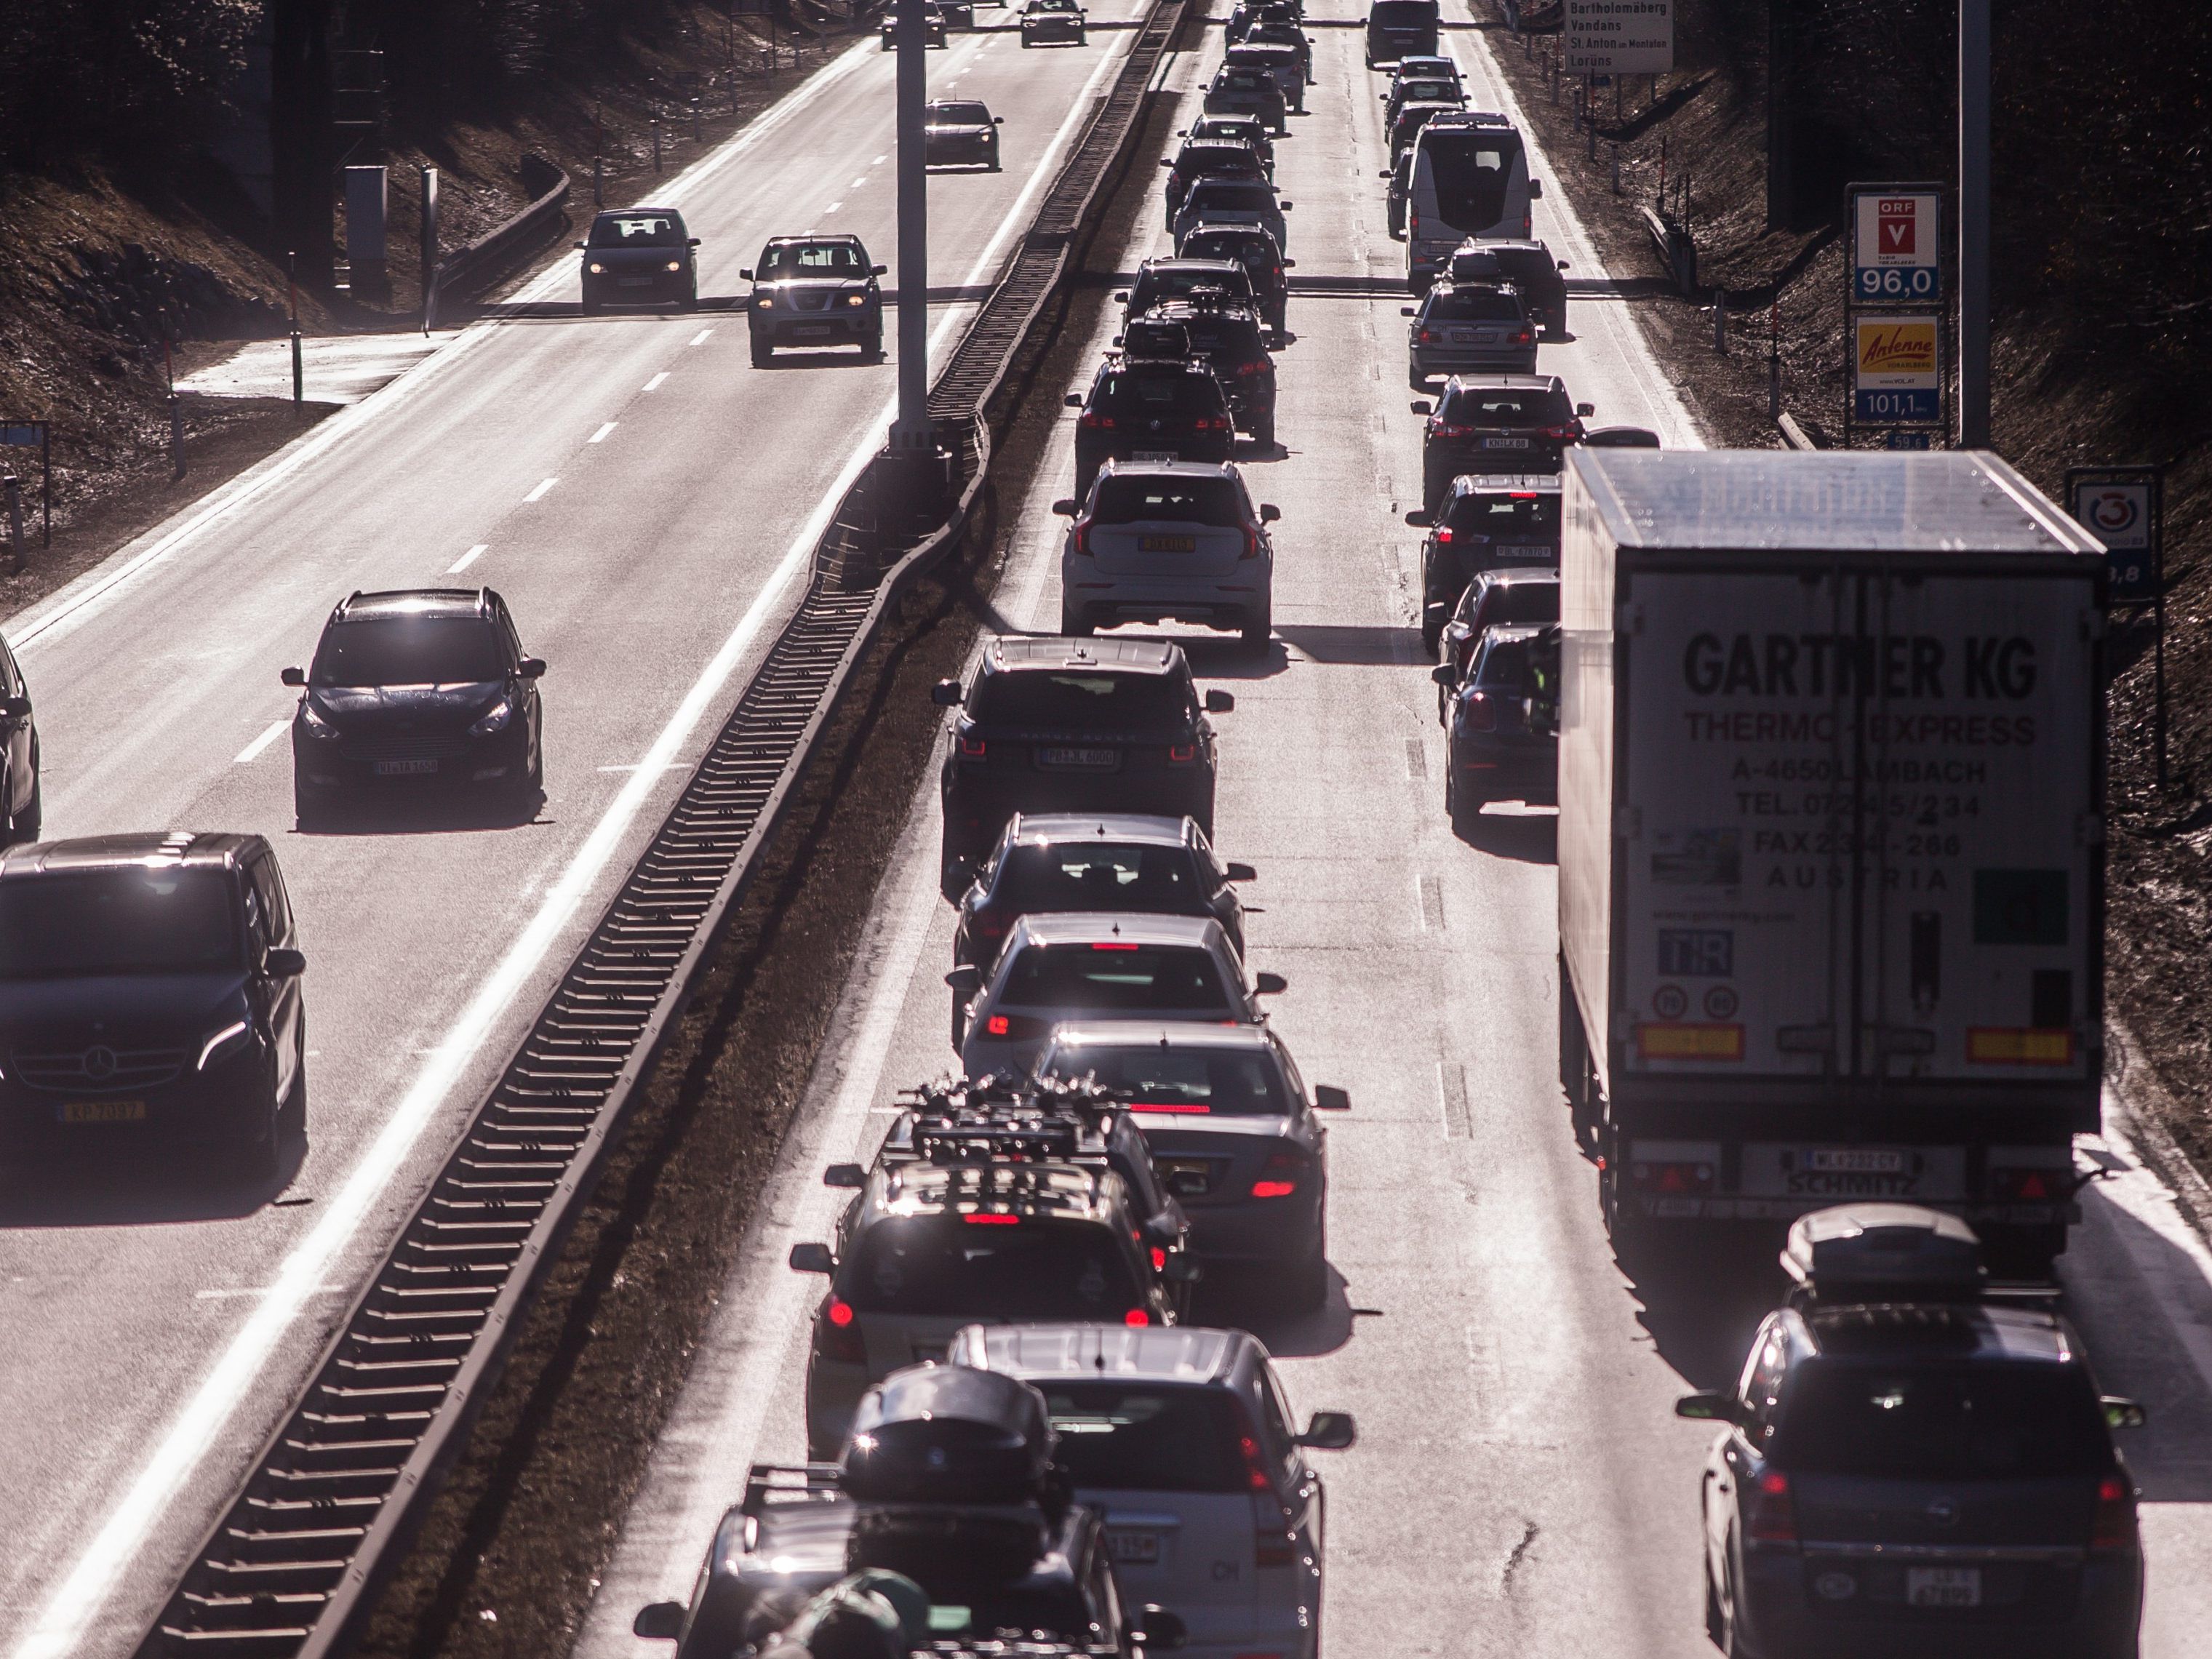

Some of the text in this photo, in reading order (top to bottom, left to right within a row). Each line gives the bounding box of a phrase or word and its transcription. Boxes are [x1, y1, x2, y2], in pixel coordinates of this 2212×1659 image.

[1571, 2, 1666, 15] Bartholomäberg
[1571, 20, 1621, 31] Vandans
[1571, 37, 1584, 49] St.
[1586, 37, 1616, 49] Anton
[1629, 39, 1666, 48] Montafon
[1571, 55, 1612, 66] Lorüns
[1881, 202, 1912, 212] ORF
[1888, 224, 1906, 247] V
[1862, 269, 1932, 298] 96,0
[1863, 327, 1932, 364] Antenne
[1868, 394, 1914, 415] 101,1
[1489, 439, 1500, 447] KN
[1684, 631, 2037, 700] GARTNER KG
[1869, 714, 2036, 746] EXPRESS
[1835, 761, 1986, 783] LAMBACH
[1754, 831, 1810, 854] FAX
[1768, 866, 1947, 890] AUSTRIA
[1788, 1174, 1920, 1196] SCHMITZ
